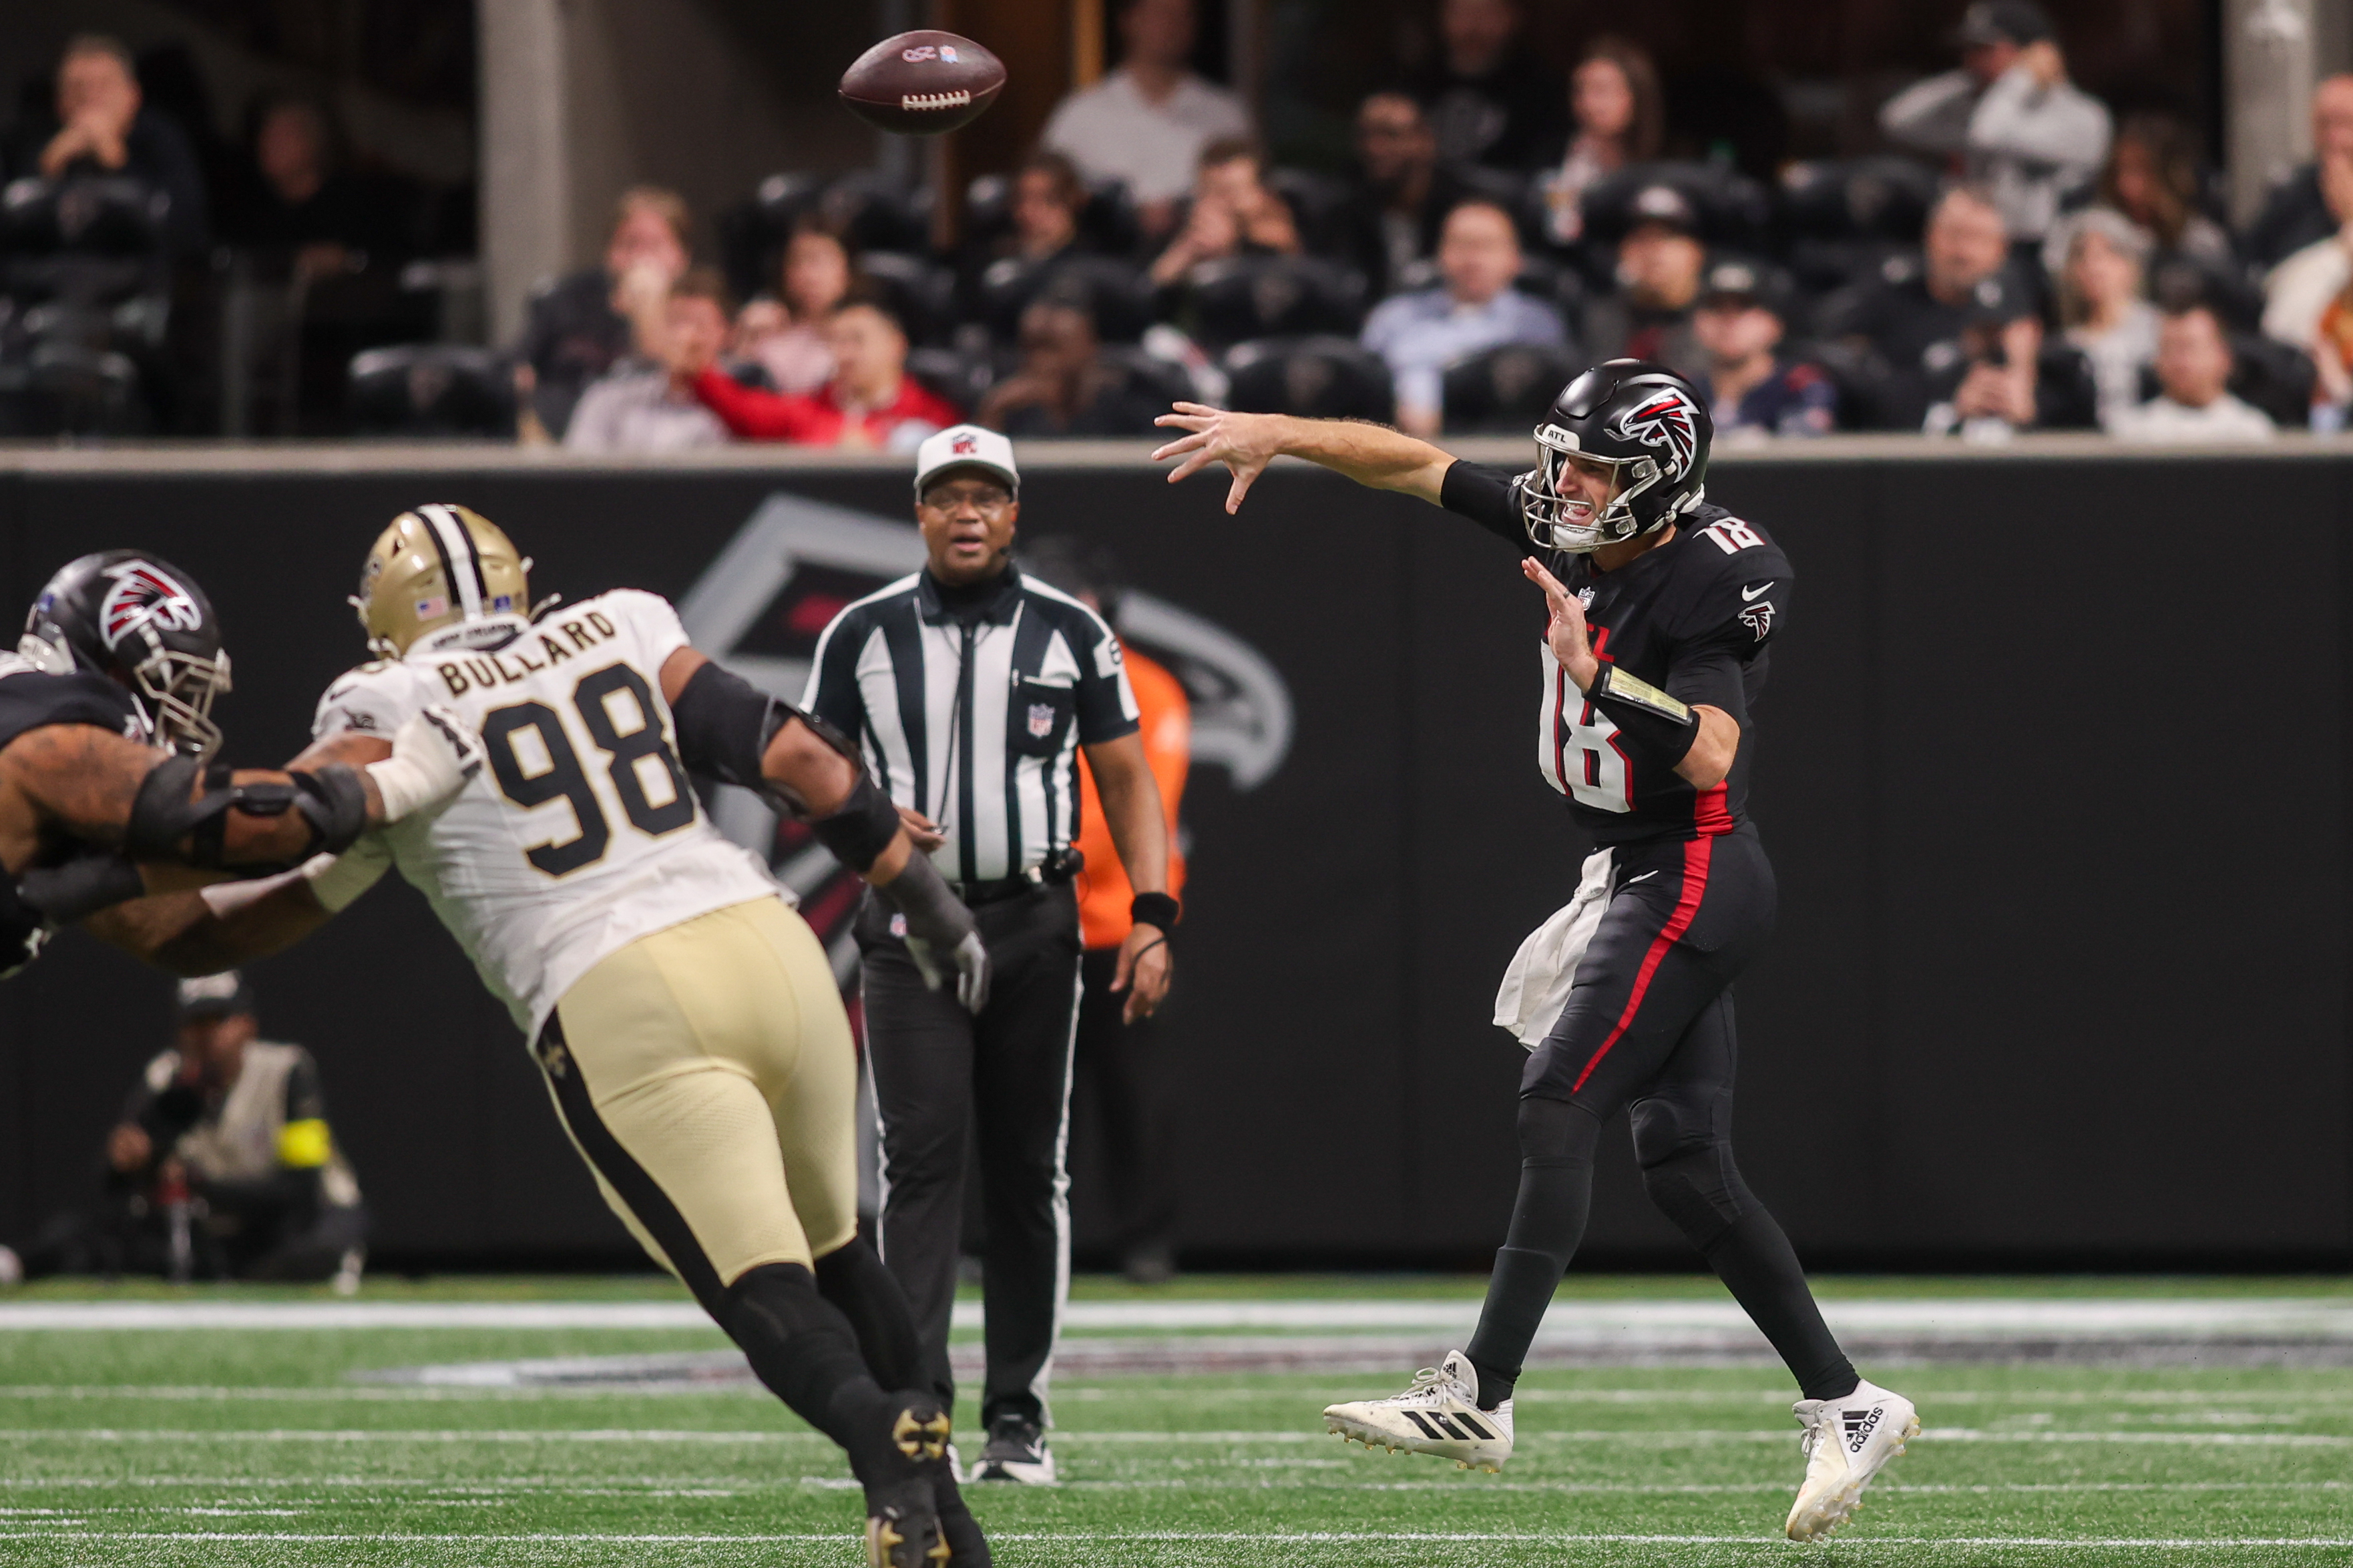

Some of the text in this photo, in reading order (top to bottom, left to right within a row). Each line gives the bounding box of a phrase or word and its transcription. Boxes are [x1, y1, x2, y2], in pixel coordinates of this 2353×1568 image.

[1548, 430, 1566, 443] ATL
[1692, 516, 1766, 555] 18
[438, 612, 616, 698] BULLARD
[1538, 638, 1637, 813] 18
[480, 662, 696, 878] 98
[1850, 1407, 1883, 1453] adidas
